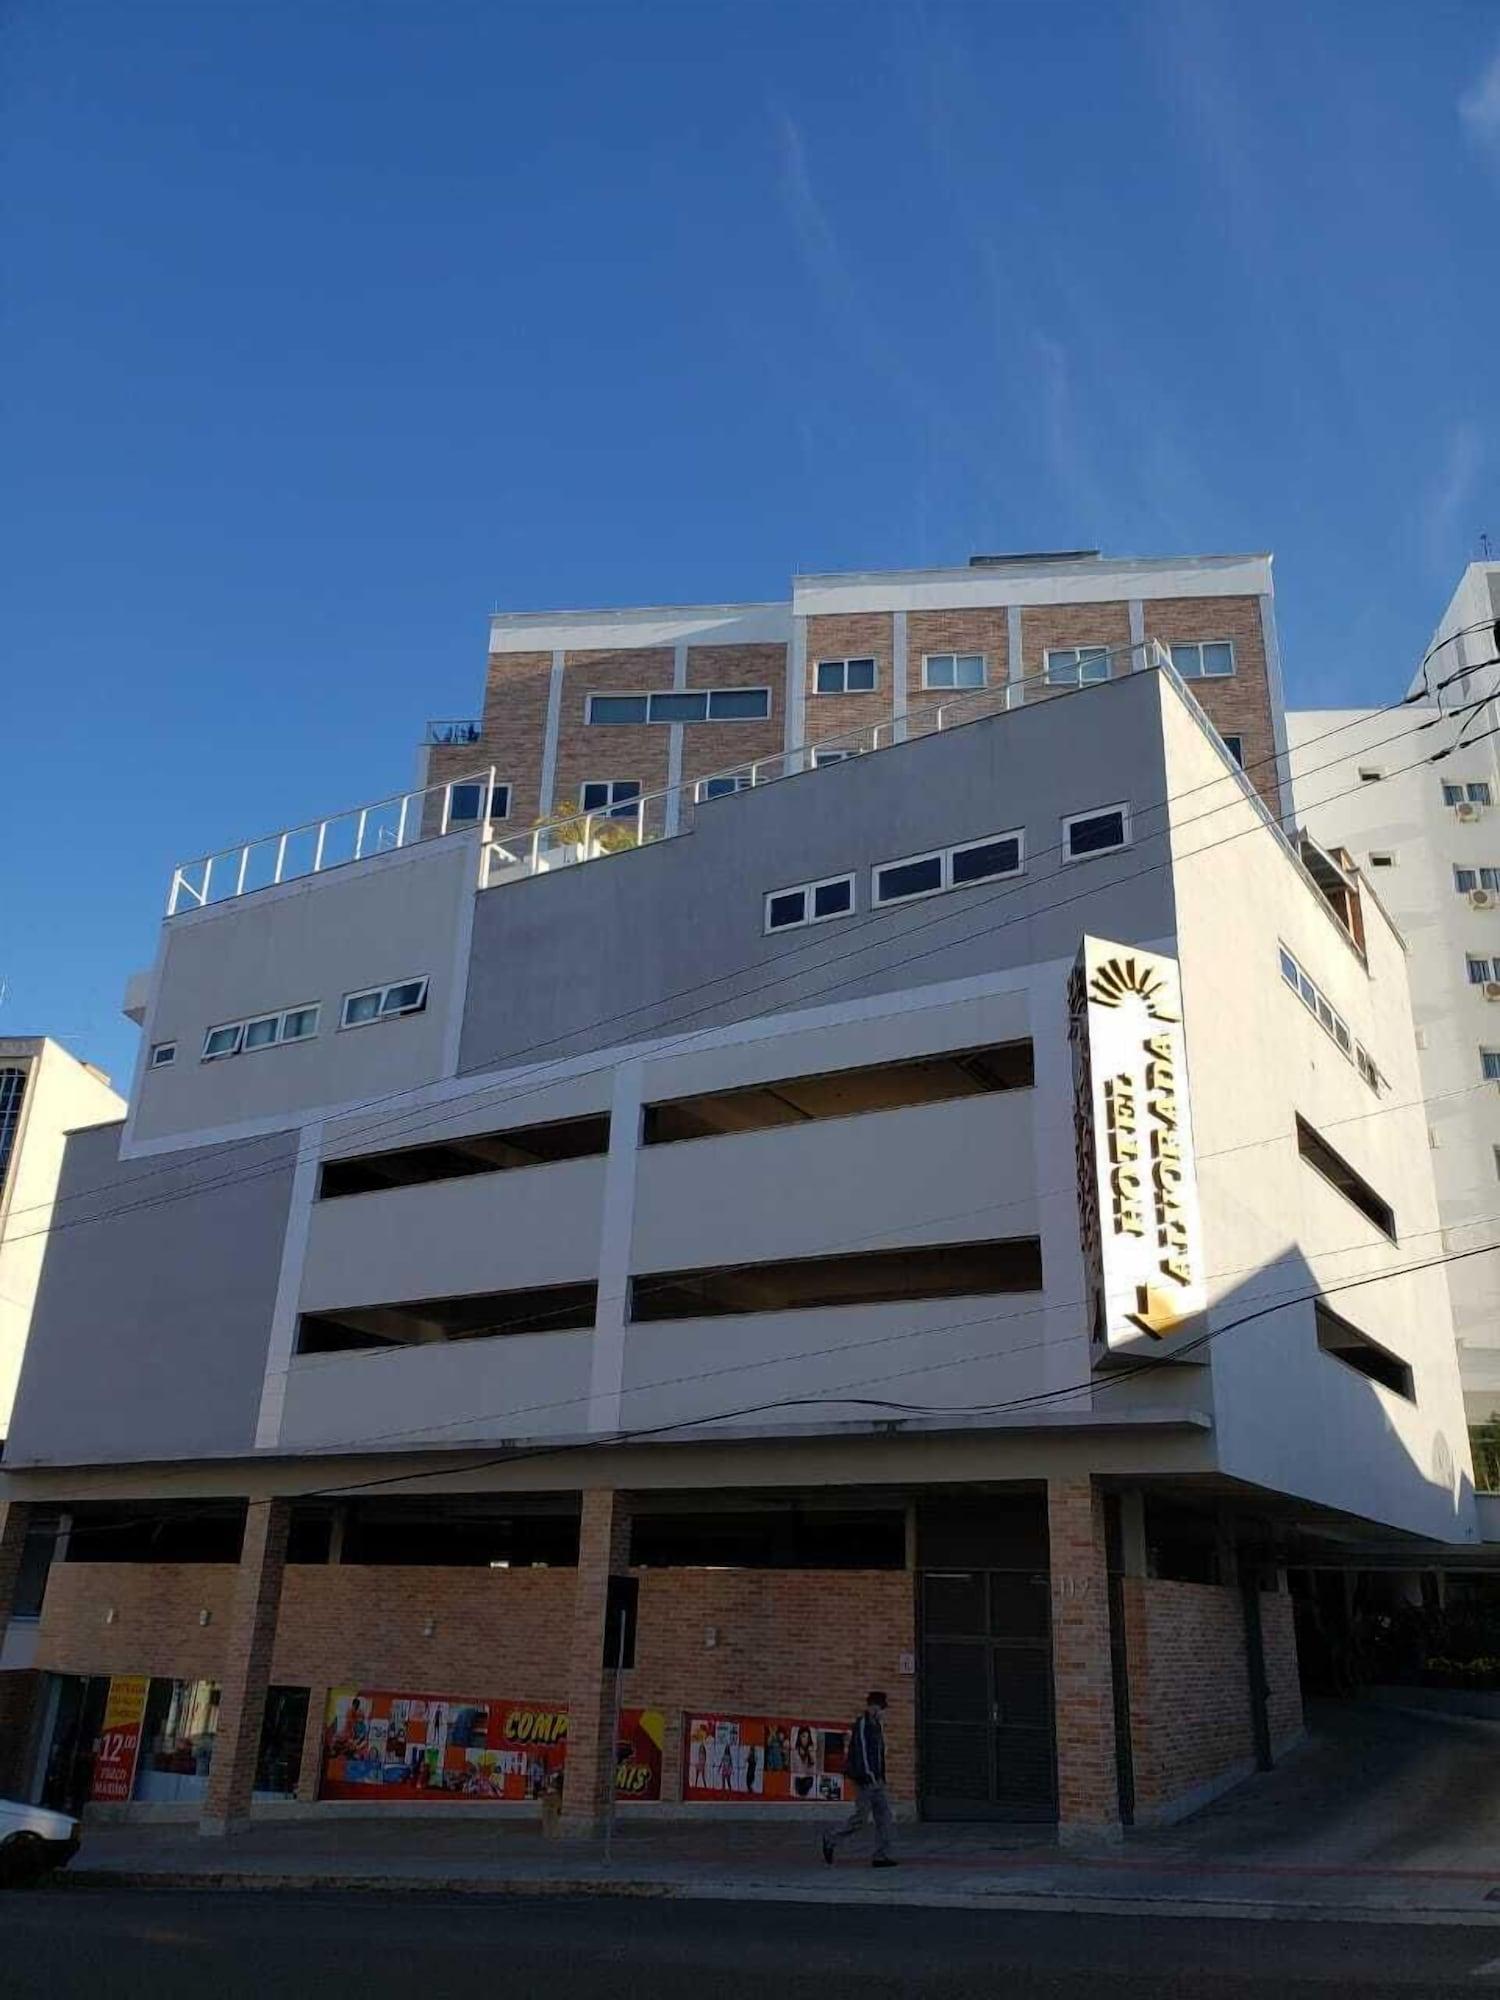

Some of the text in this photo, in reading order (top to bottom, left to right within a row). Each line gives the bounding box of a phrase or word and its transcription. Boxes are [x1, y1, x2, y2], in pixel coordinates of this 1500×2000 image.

[1104, 1073, 1143, 1239] HOTEL
[1143, 1032, 1191, 1287] ALVORADA
[505, 1711, 569, 1743] COMP
[614, 1763, 650, 1791] AIS
